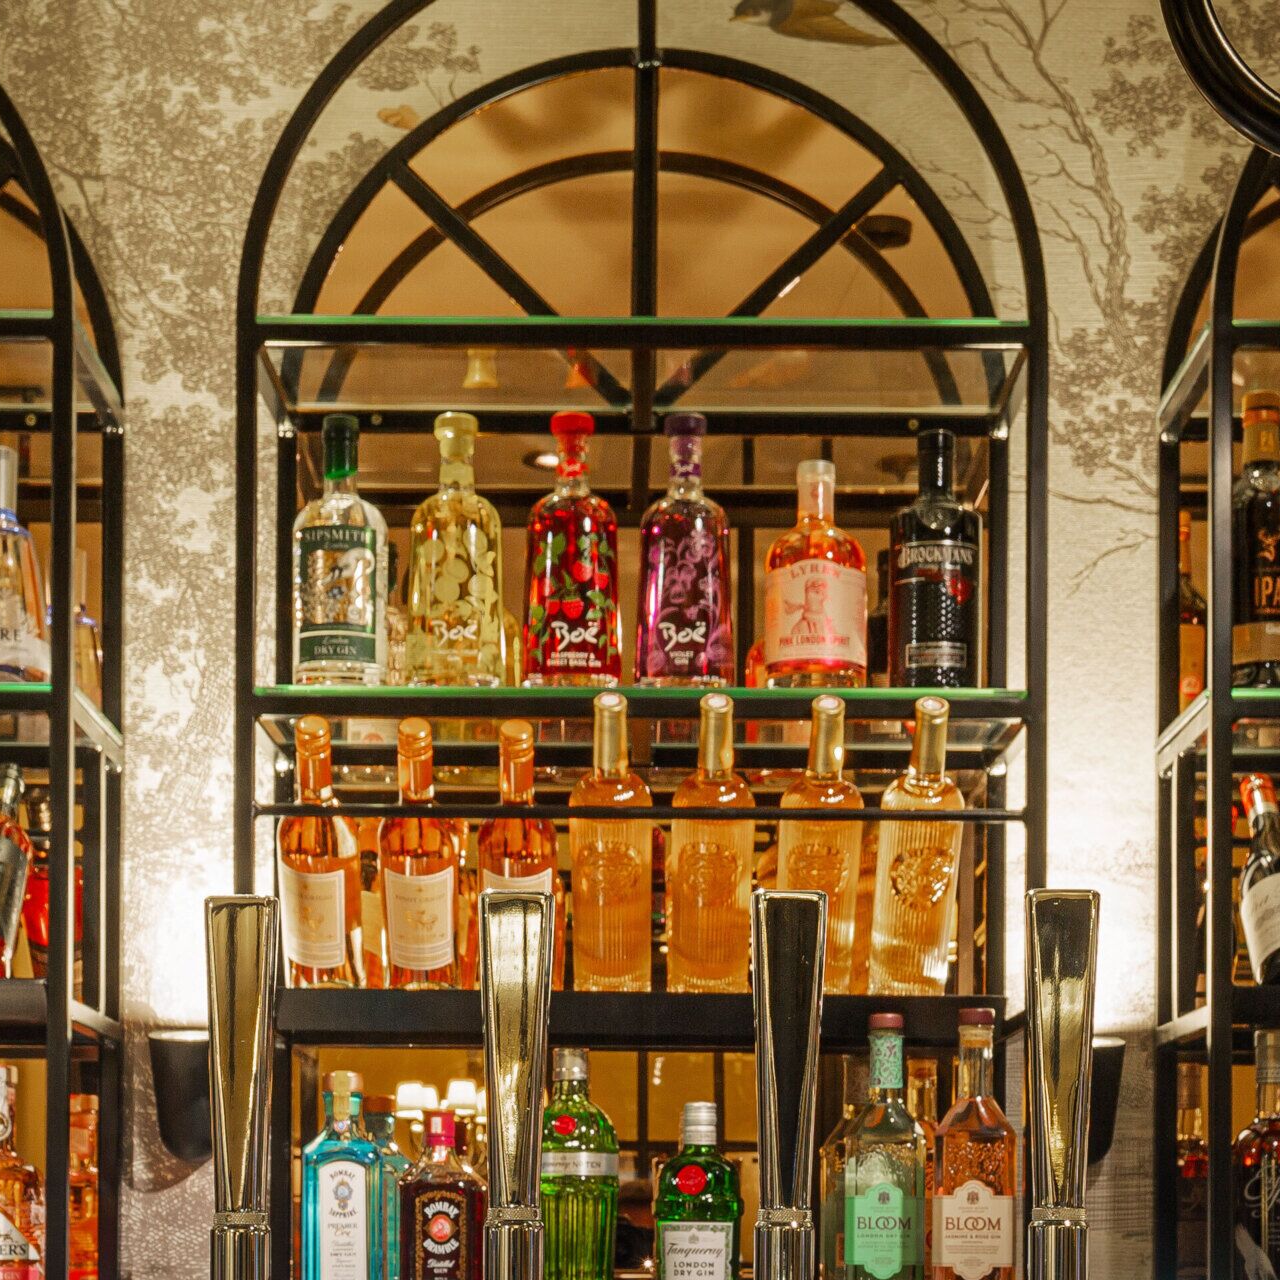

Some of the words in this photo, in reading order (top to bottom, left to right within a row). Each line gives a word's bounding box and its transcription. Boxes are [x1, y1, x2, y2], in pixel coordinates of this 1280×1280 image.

[423, 1201, 460, 1219] BOMBAY
[857, 1216, 911, 1230] BLOOM
[945, 1216, 1001, 1231] BLOOM
